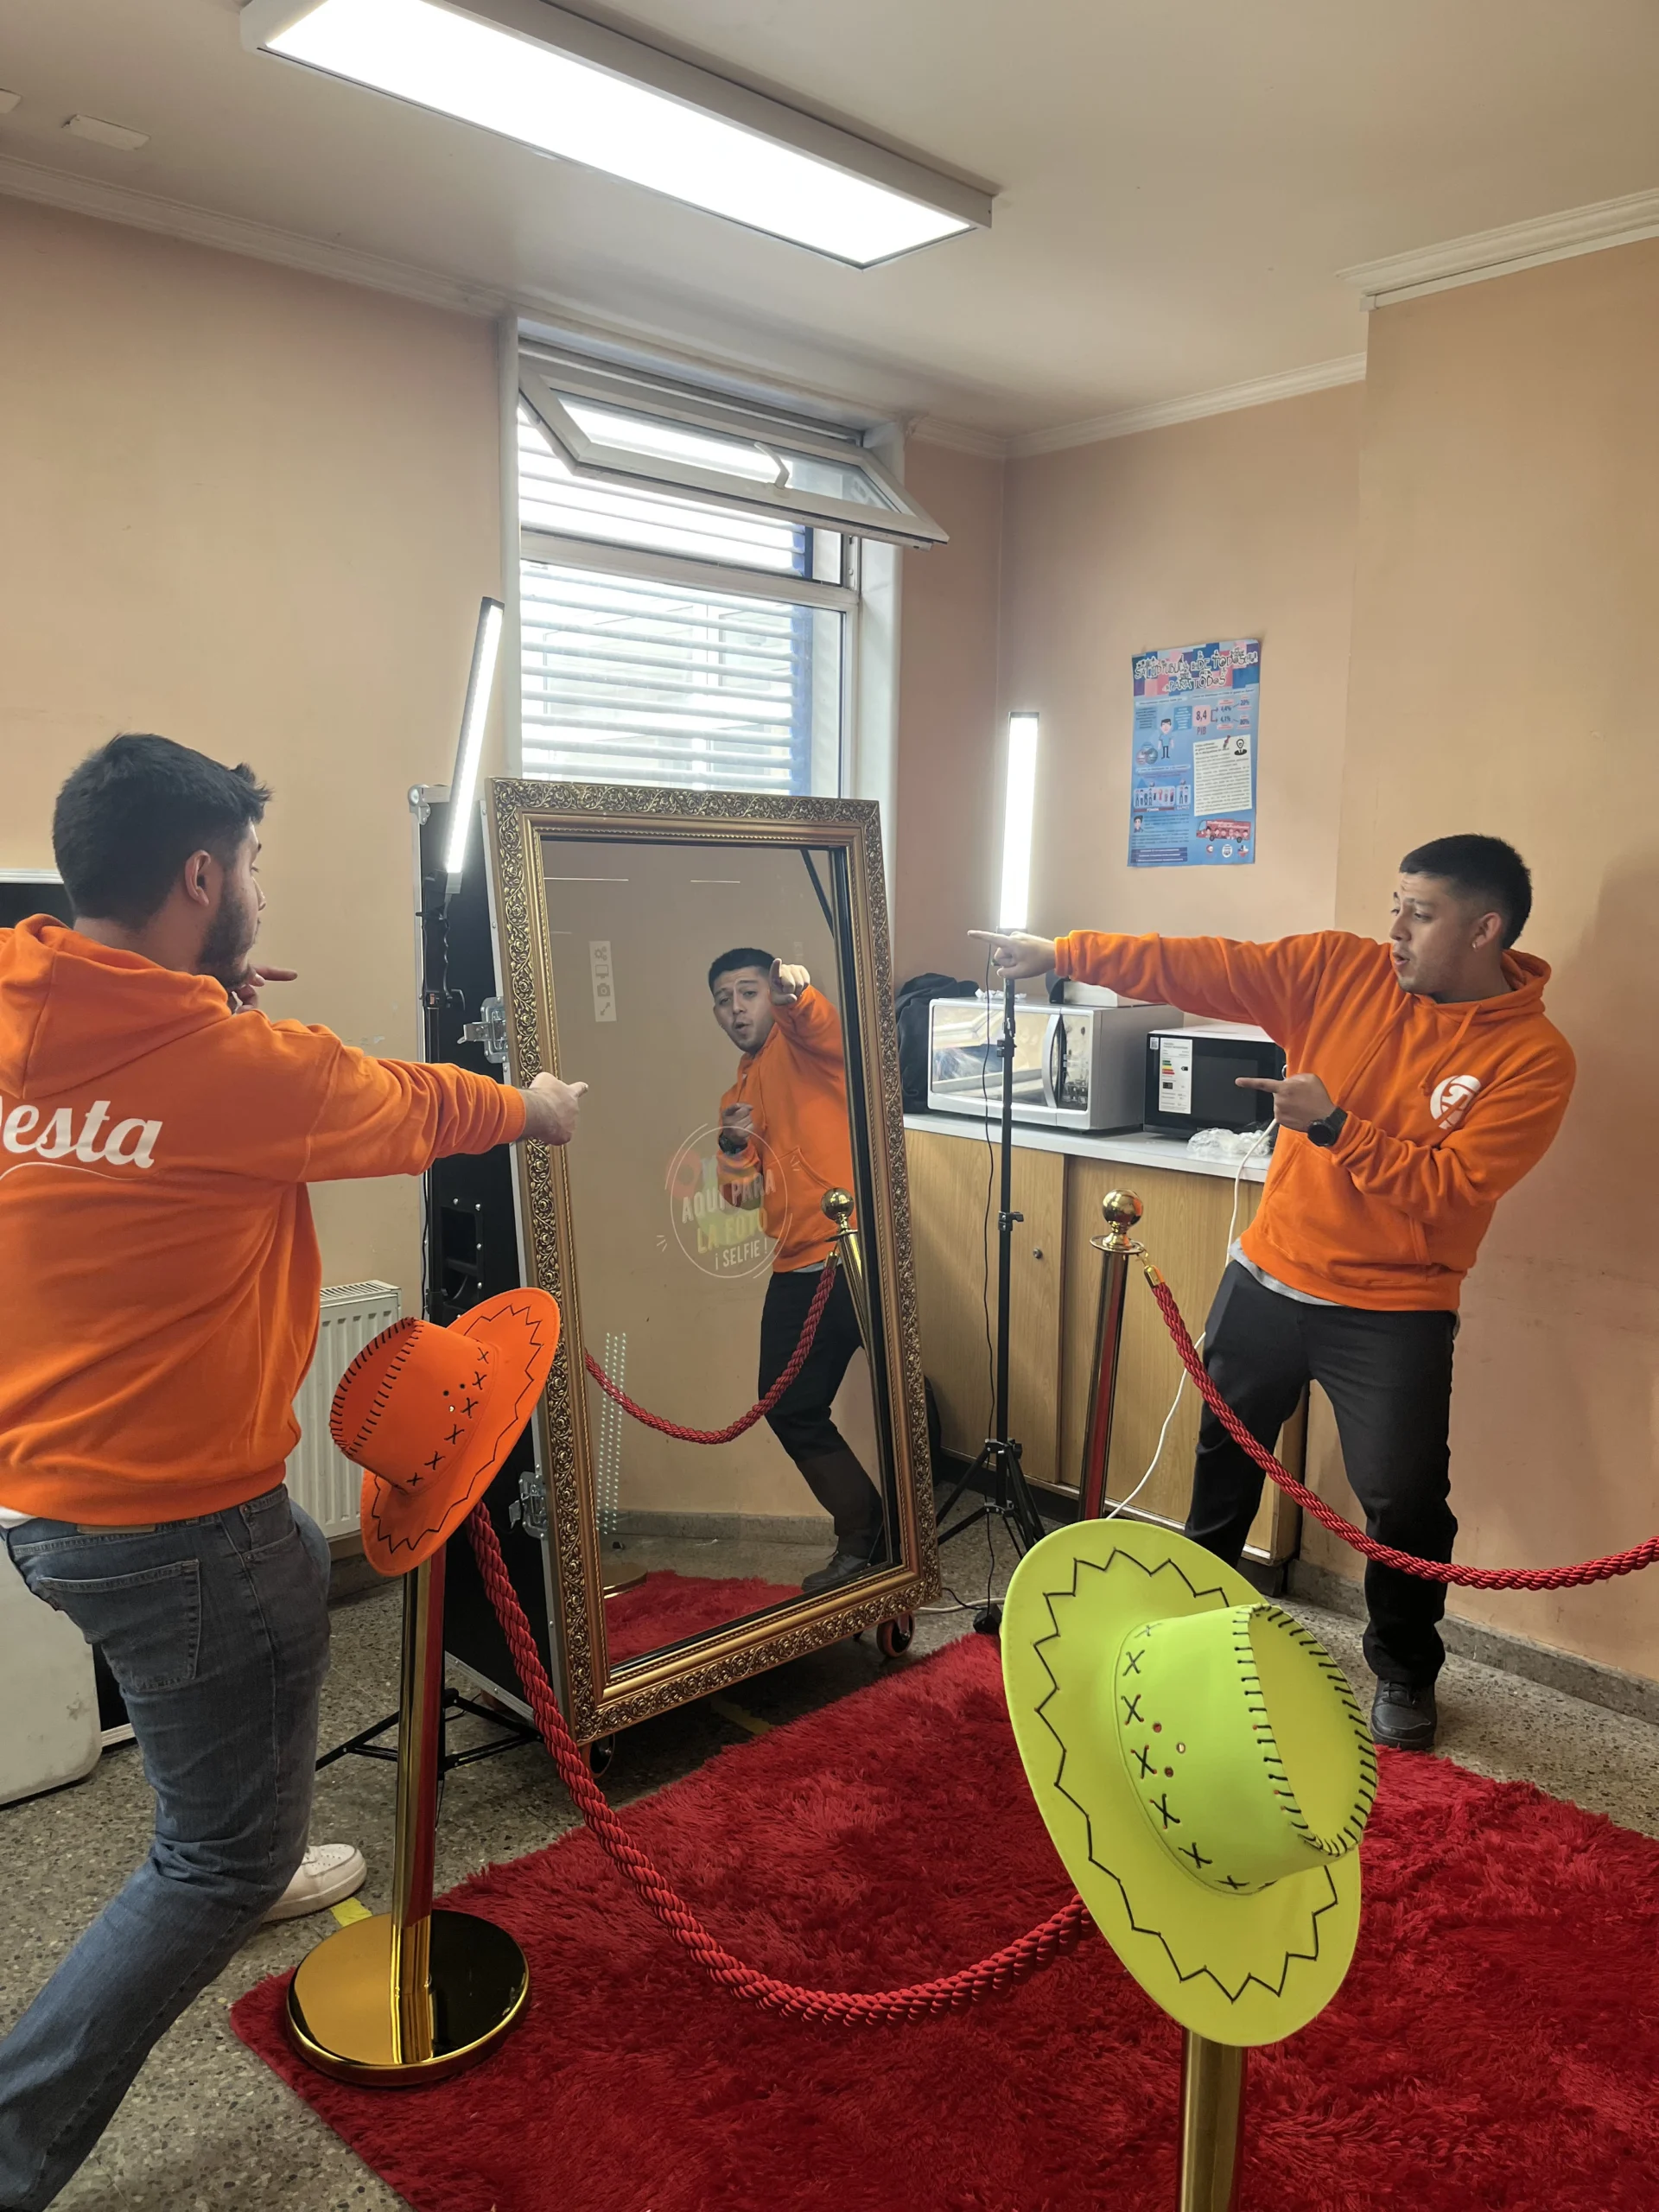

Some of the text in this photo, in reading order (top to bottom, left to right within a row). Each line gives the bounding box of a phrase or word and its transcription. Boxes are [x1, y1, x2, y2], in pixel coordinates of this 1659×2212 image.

[1196, 710, 1207, 721] 8,4
[1197, 727, 1207, 735] PIB
[0, 1096, 162, 1168] esta
[731, 1169, 776, 1205] PARA
[697, 1208, 767, 1254] LA FOTO
